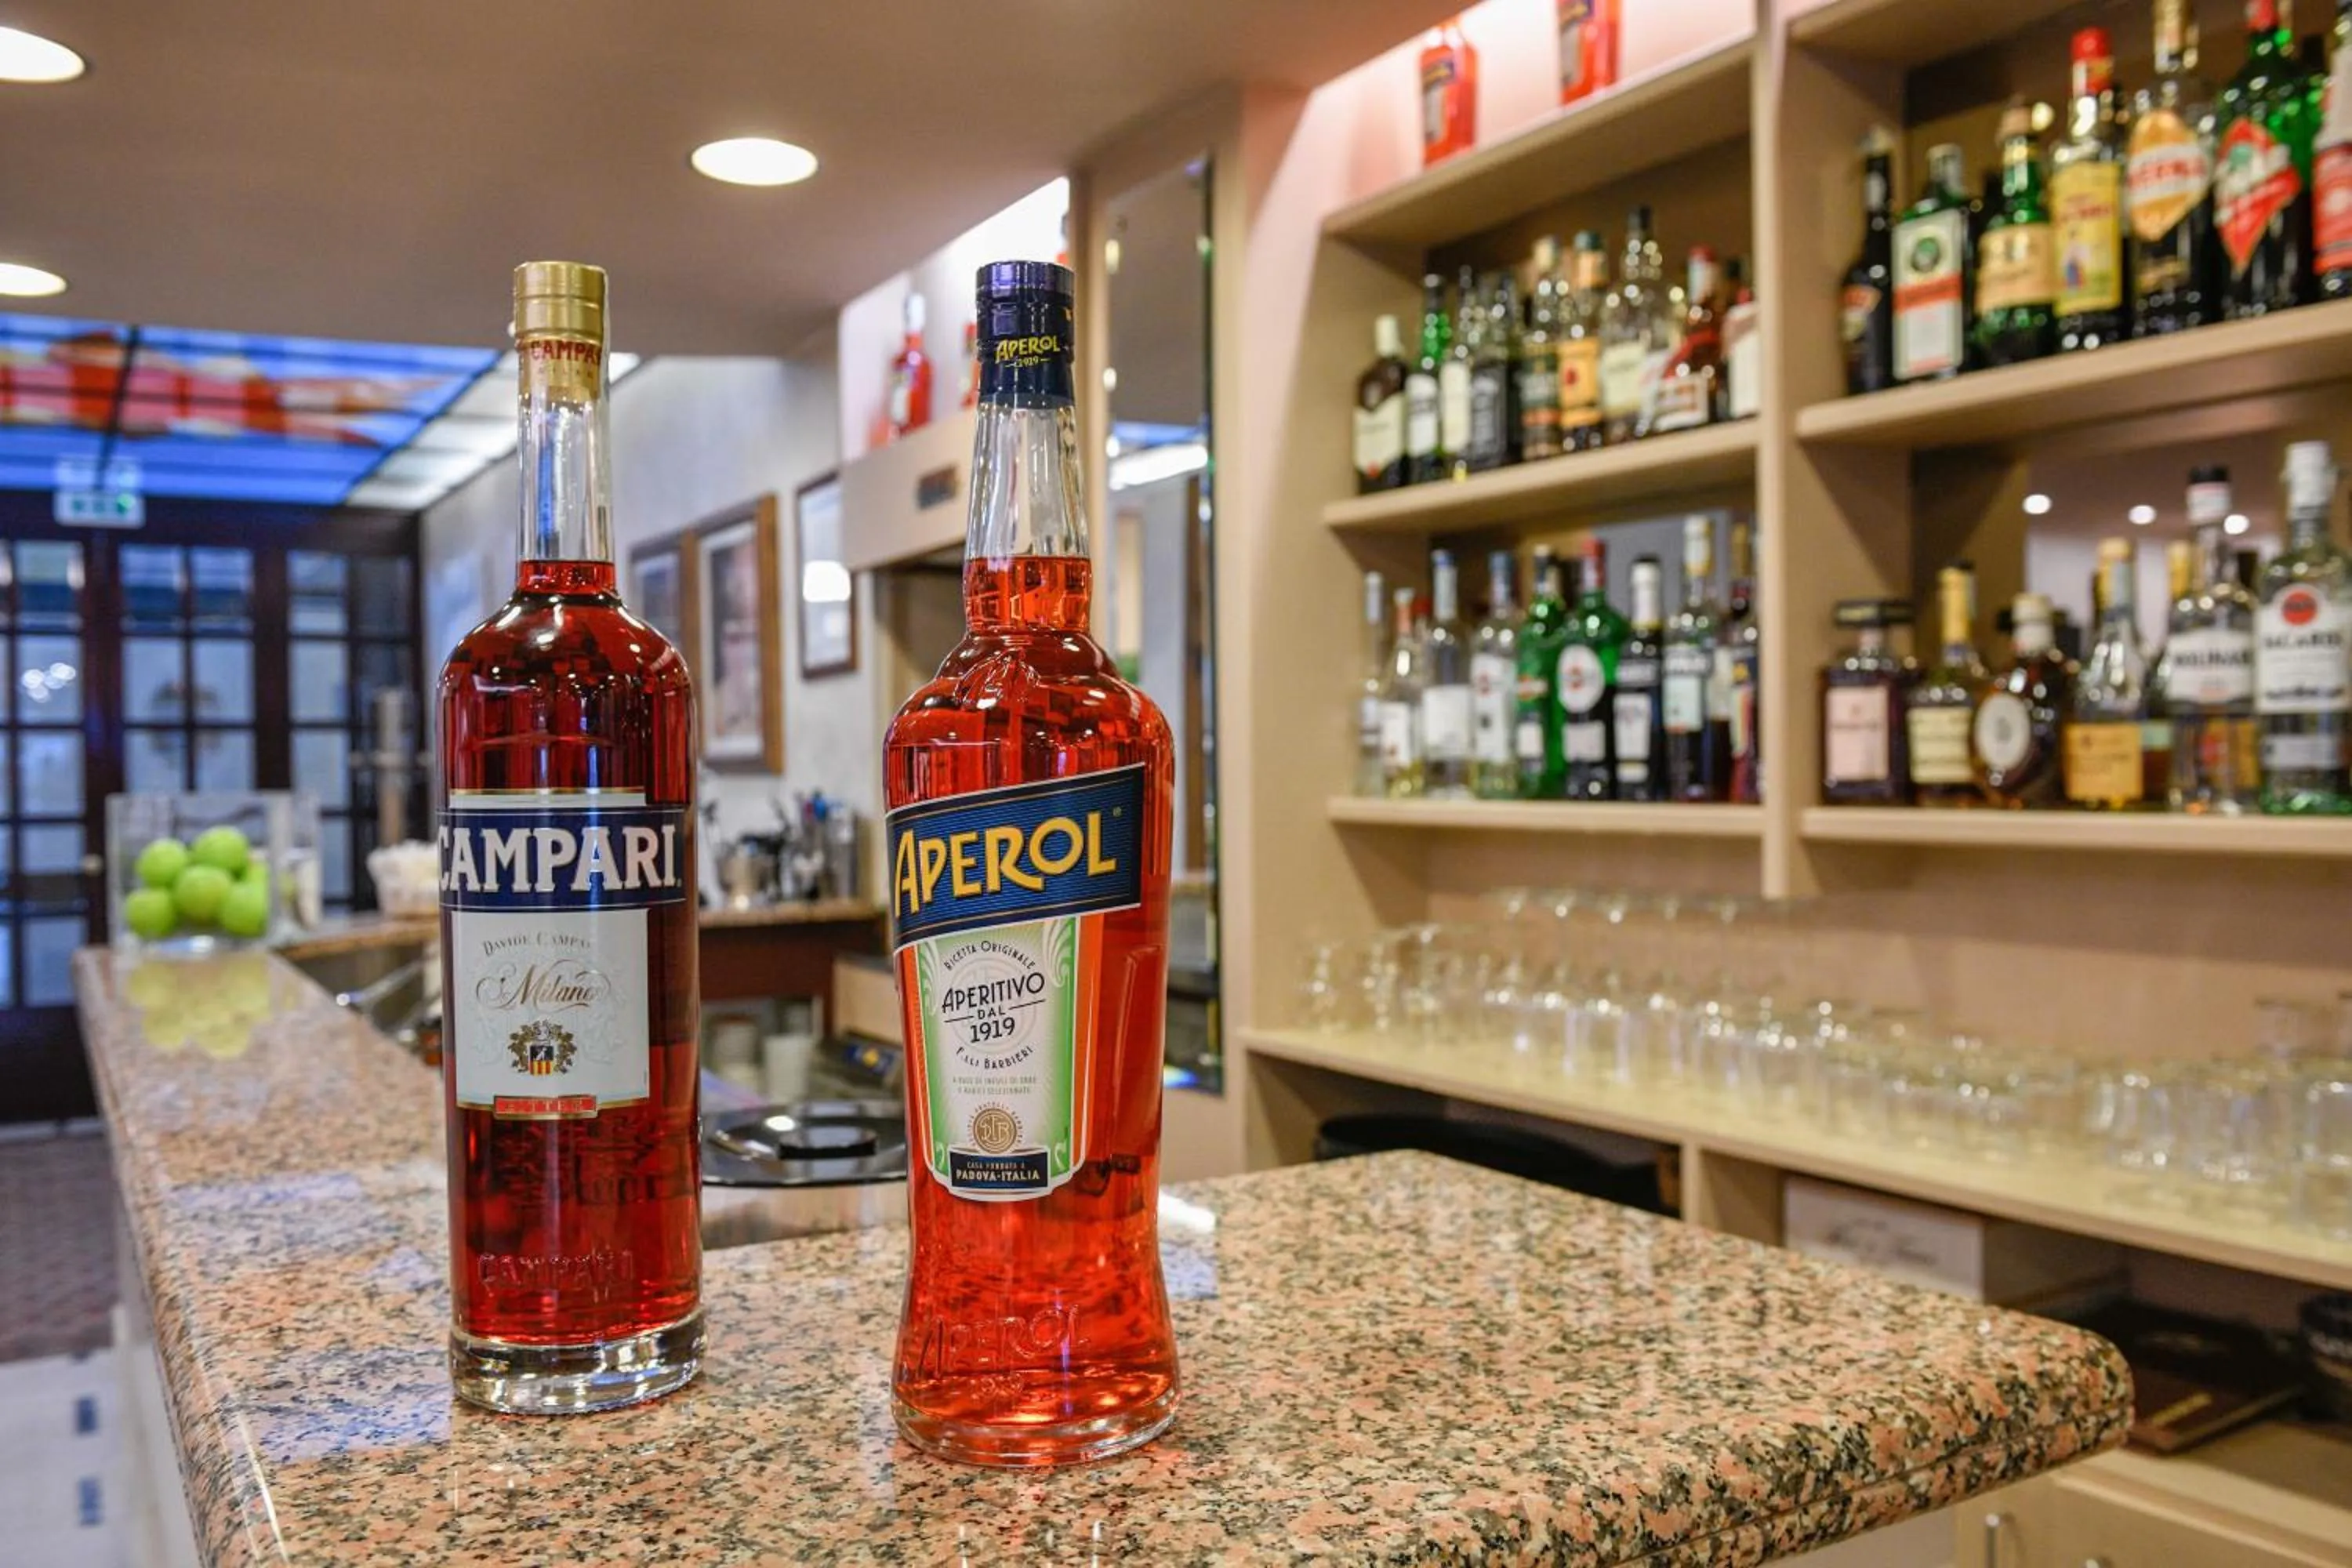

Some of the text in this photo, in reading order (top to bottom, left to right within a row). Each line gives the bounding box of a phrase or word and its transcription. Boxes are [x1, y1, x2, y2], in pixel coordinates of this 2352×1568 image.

[995, 336, 1060, 364] APEROL
[437, 825, 676, 892] CAMPARI
[895, 811, 1117, 918] APEROL
[943, 940, 1036, 971] RICETTA ORIGINALE
[942, 972, 1045, 1013] APERITIVO
[977, 1007, 1006, 1020] DAL
[970, 1017, 1015, 1044] 1919
[984, 1045, 1033, 1069] BARBIERI
[956, 1169, 1040, 1181] PADOVA-ITALIA
